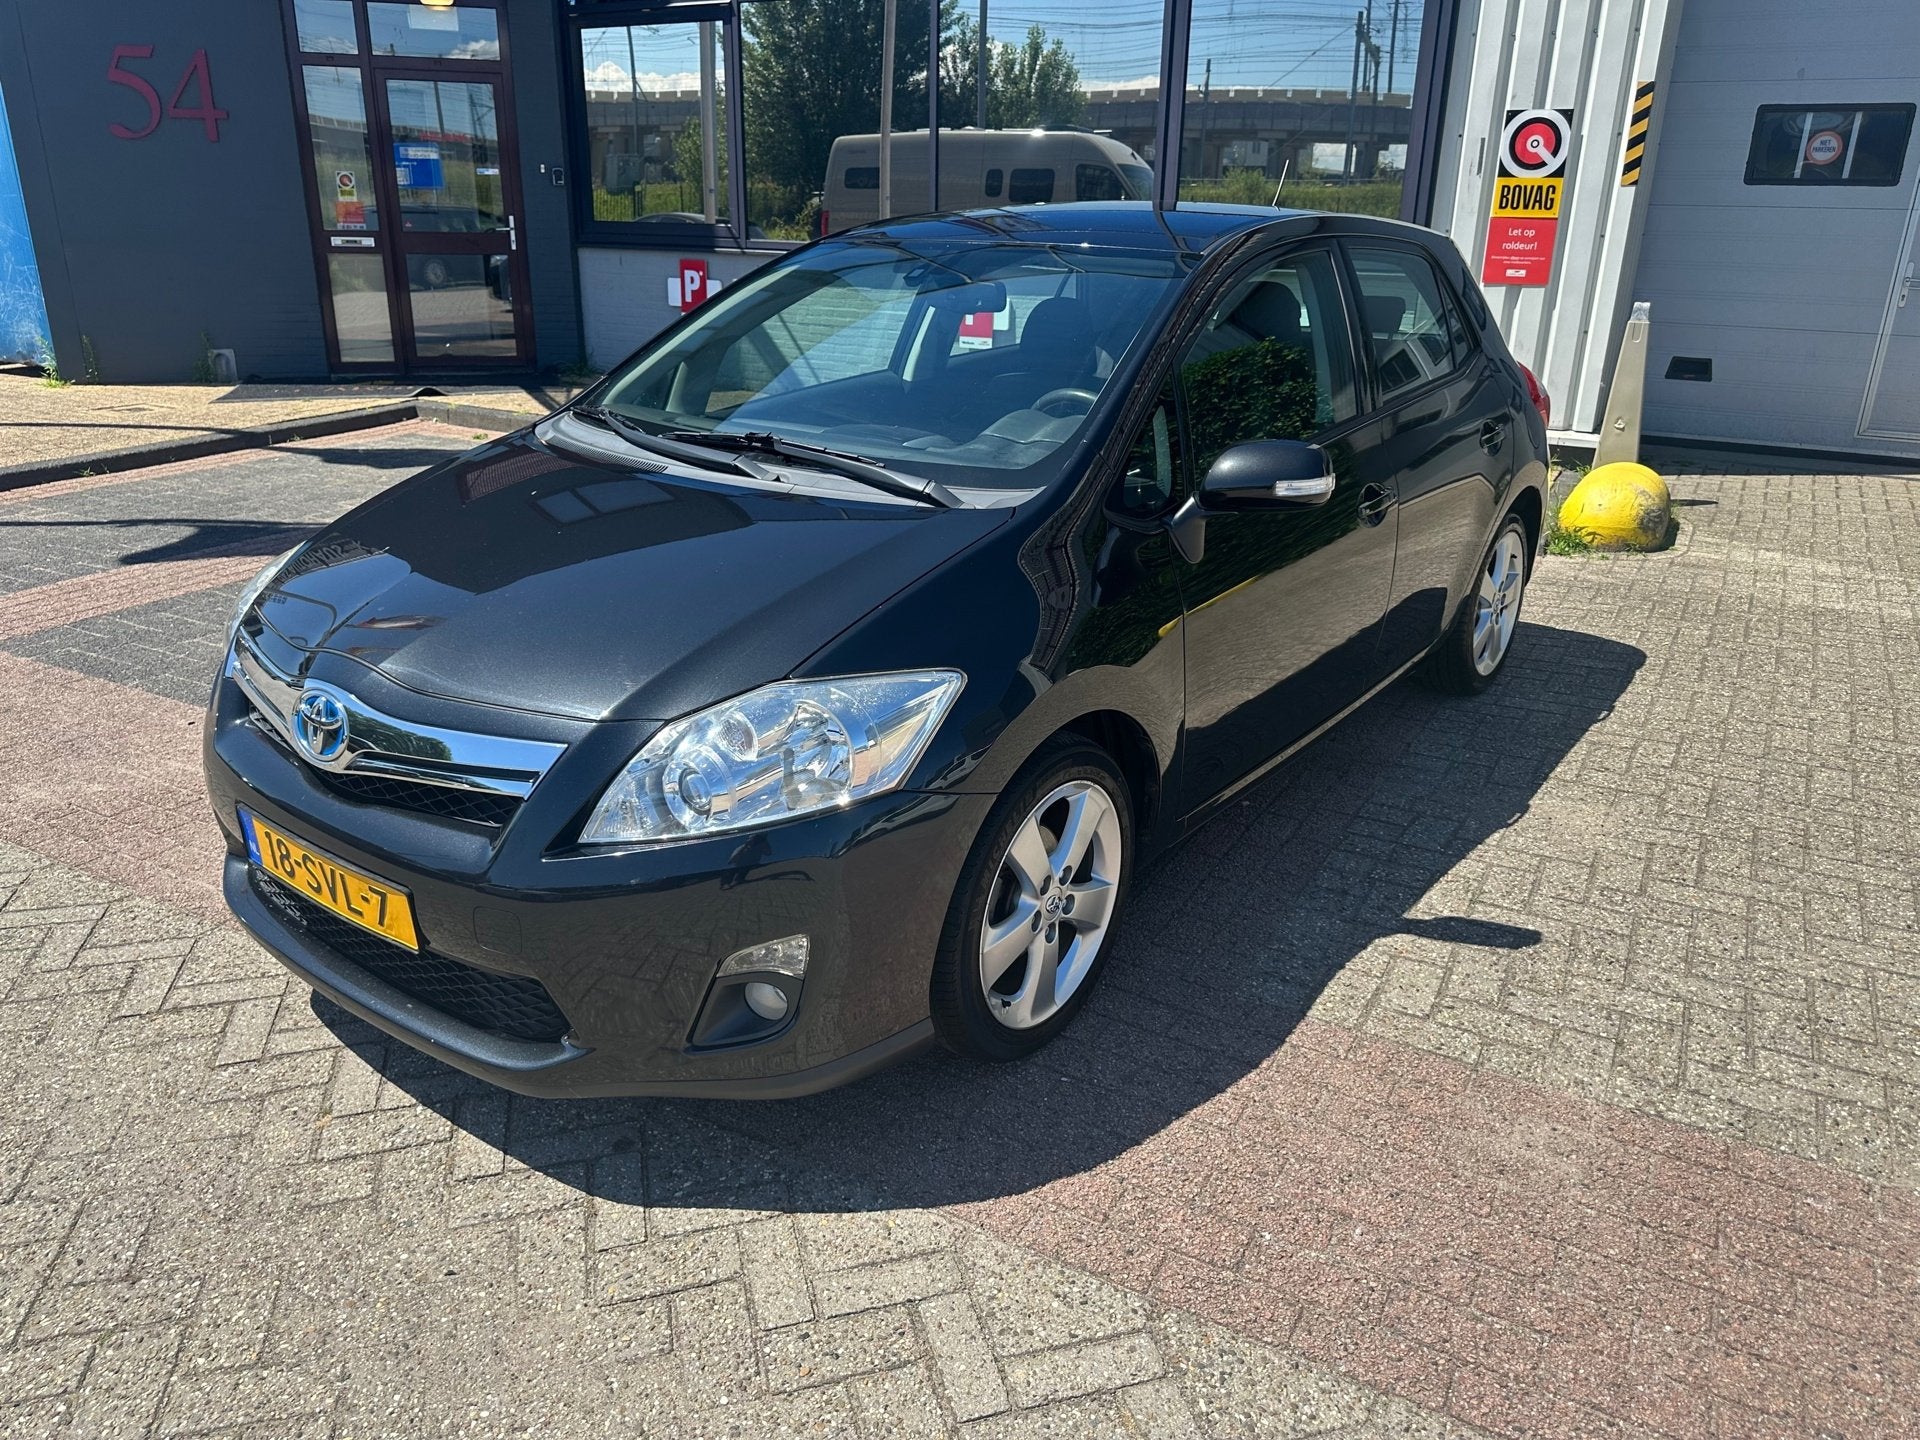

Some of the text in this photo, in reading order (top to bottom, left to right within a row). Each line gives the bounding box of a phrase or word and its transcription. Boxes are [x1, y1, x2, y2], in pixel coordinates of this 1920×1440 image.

[107, 43, 229, 143] 54
[1499, 185, 1556, 210] BOVAG
[1508, 228, 1535, 237] Let op
[1502, 241, 1537, 250] roldeur!
[264, 829, 389, 928] 18-SVL-7
